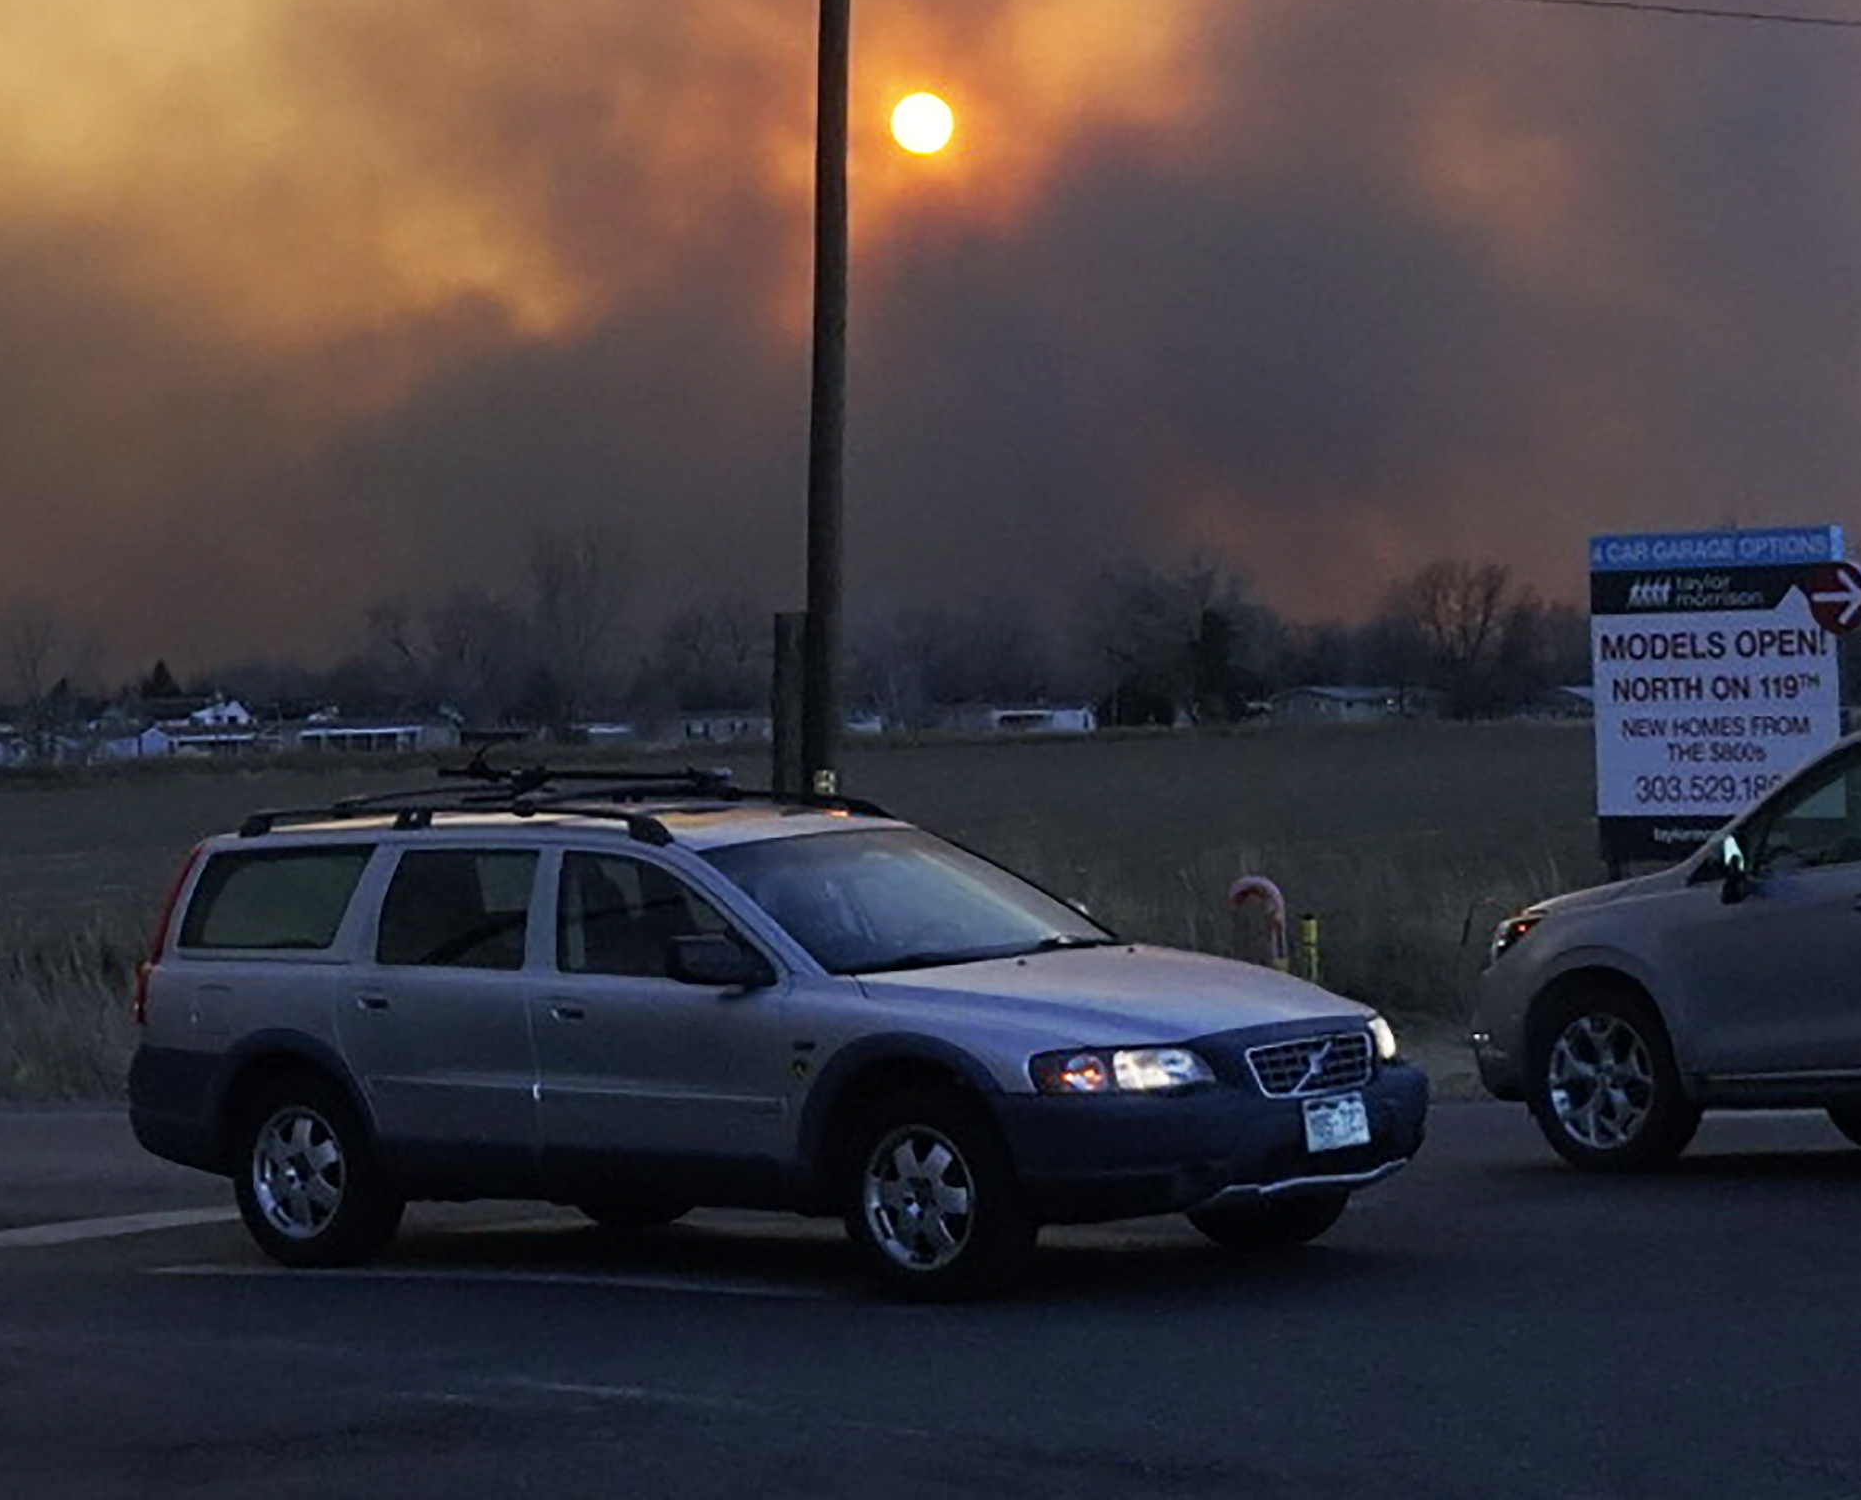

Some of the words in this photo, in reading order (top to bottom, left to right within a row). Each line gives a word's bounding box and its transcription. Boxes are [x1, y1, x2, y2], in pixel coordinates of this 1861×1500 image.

[1605, 540, 1649, 563] CAR
[1651, 537, 1735, 562] GARAGE
[1738, 533, 1829, 557] OPTIONS
[1675, 573, 1731, 597] taylor
[1674, 589, 1764, 606] morrison
[1600, 630, 1726, 661] MODELS
[1735, 628, 1827, 658] OPEN!
[1612, 676, 1703, 701] NORTH
[1711, 675, 1750, 699] ON
[1622, 718, 1667, 739] NEW
[1673, 716, 1746, 738] HOMES
[1750, 715, 1811, 735] FROM
[1666, 742, 1706, 763] THE
[1710, 741, 1767, 763] $800s
